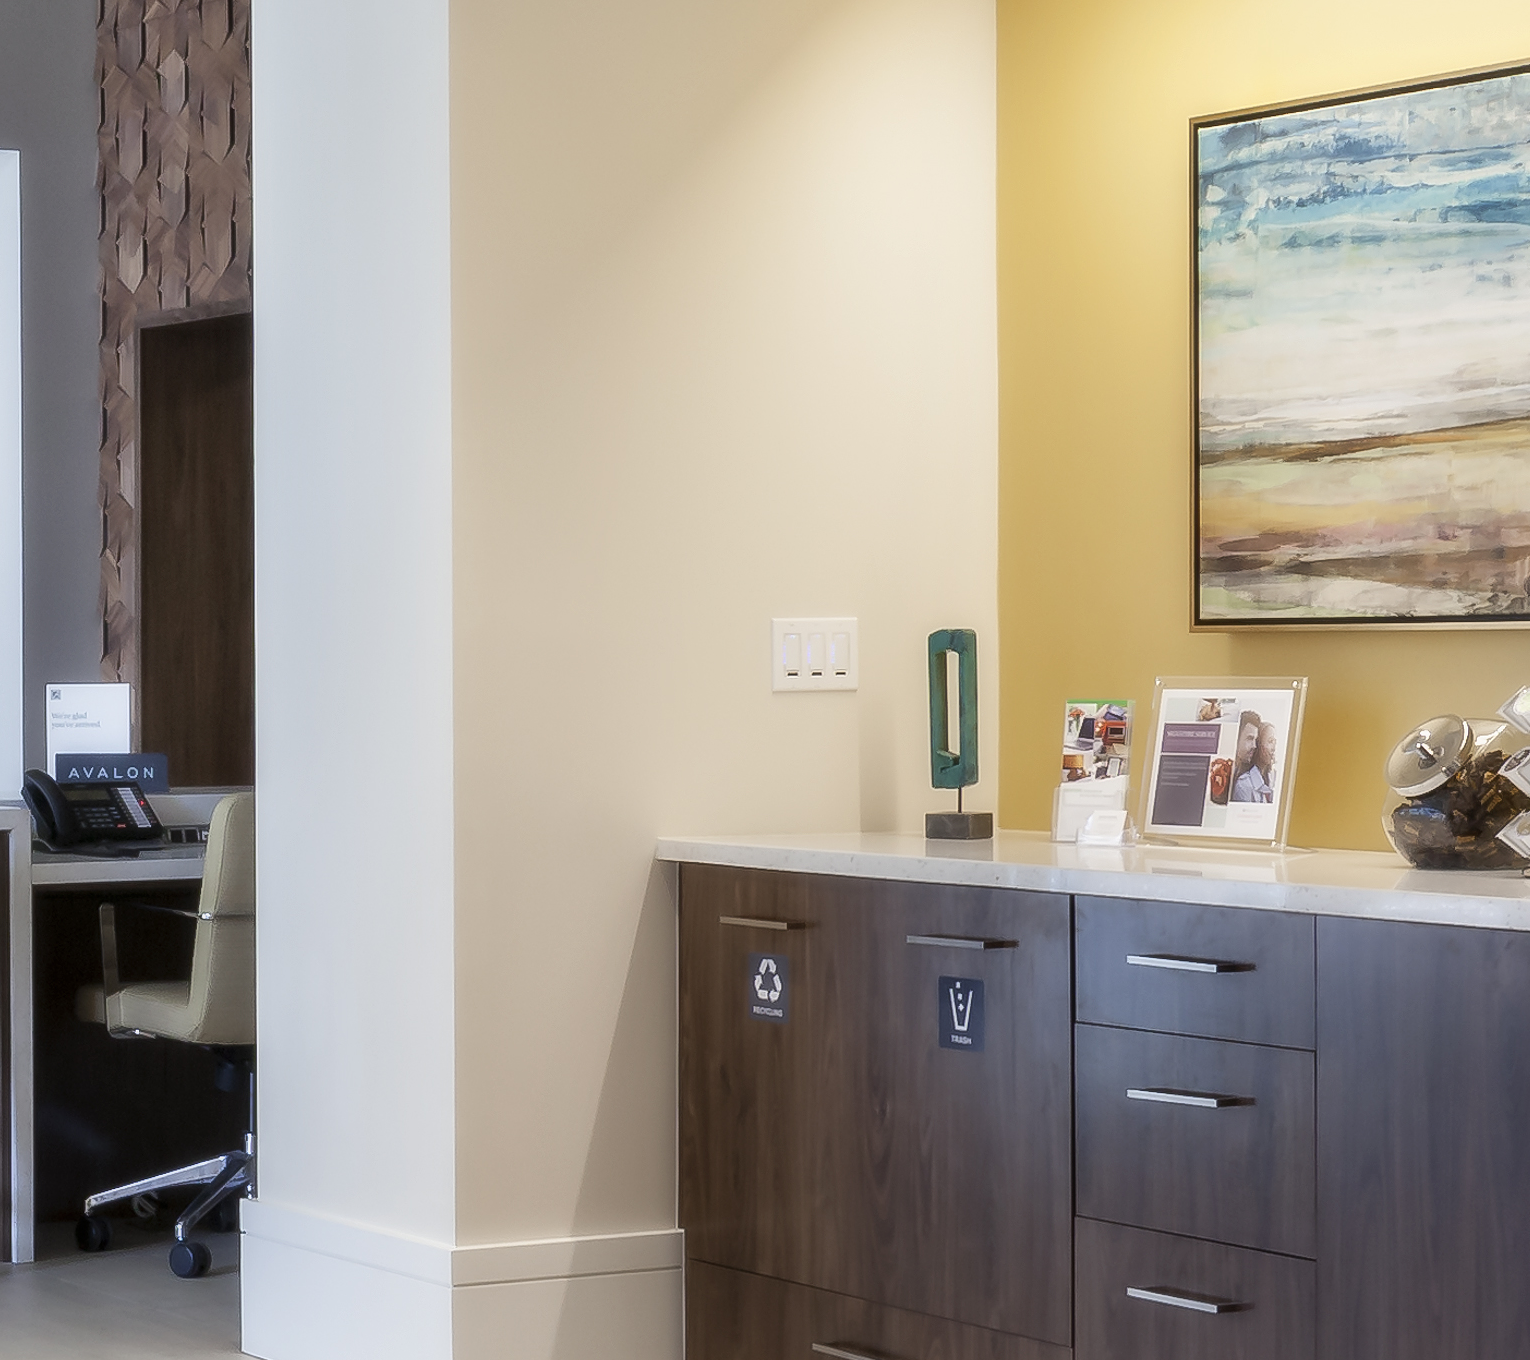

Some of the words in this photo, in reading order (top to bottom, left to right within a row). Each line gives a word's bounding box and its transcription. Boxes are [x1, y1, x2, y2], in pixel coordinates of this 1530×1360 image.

[72, 712, 87, 721] glad
[68, 766, 154, 779] AVALON
[752, 1005, 783, 1017] RECYCLING
[950, 1034, 972, 1045] TRASH
